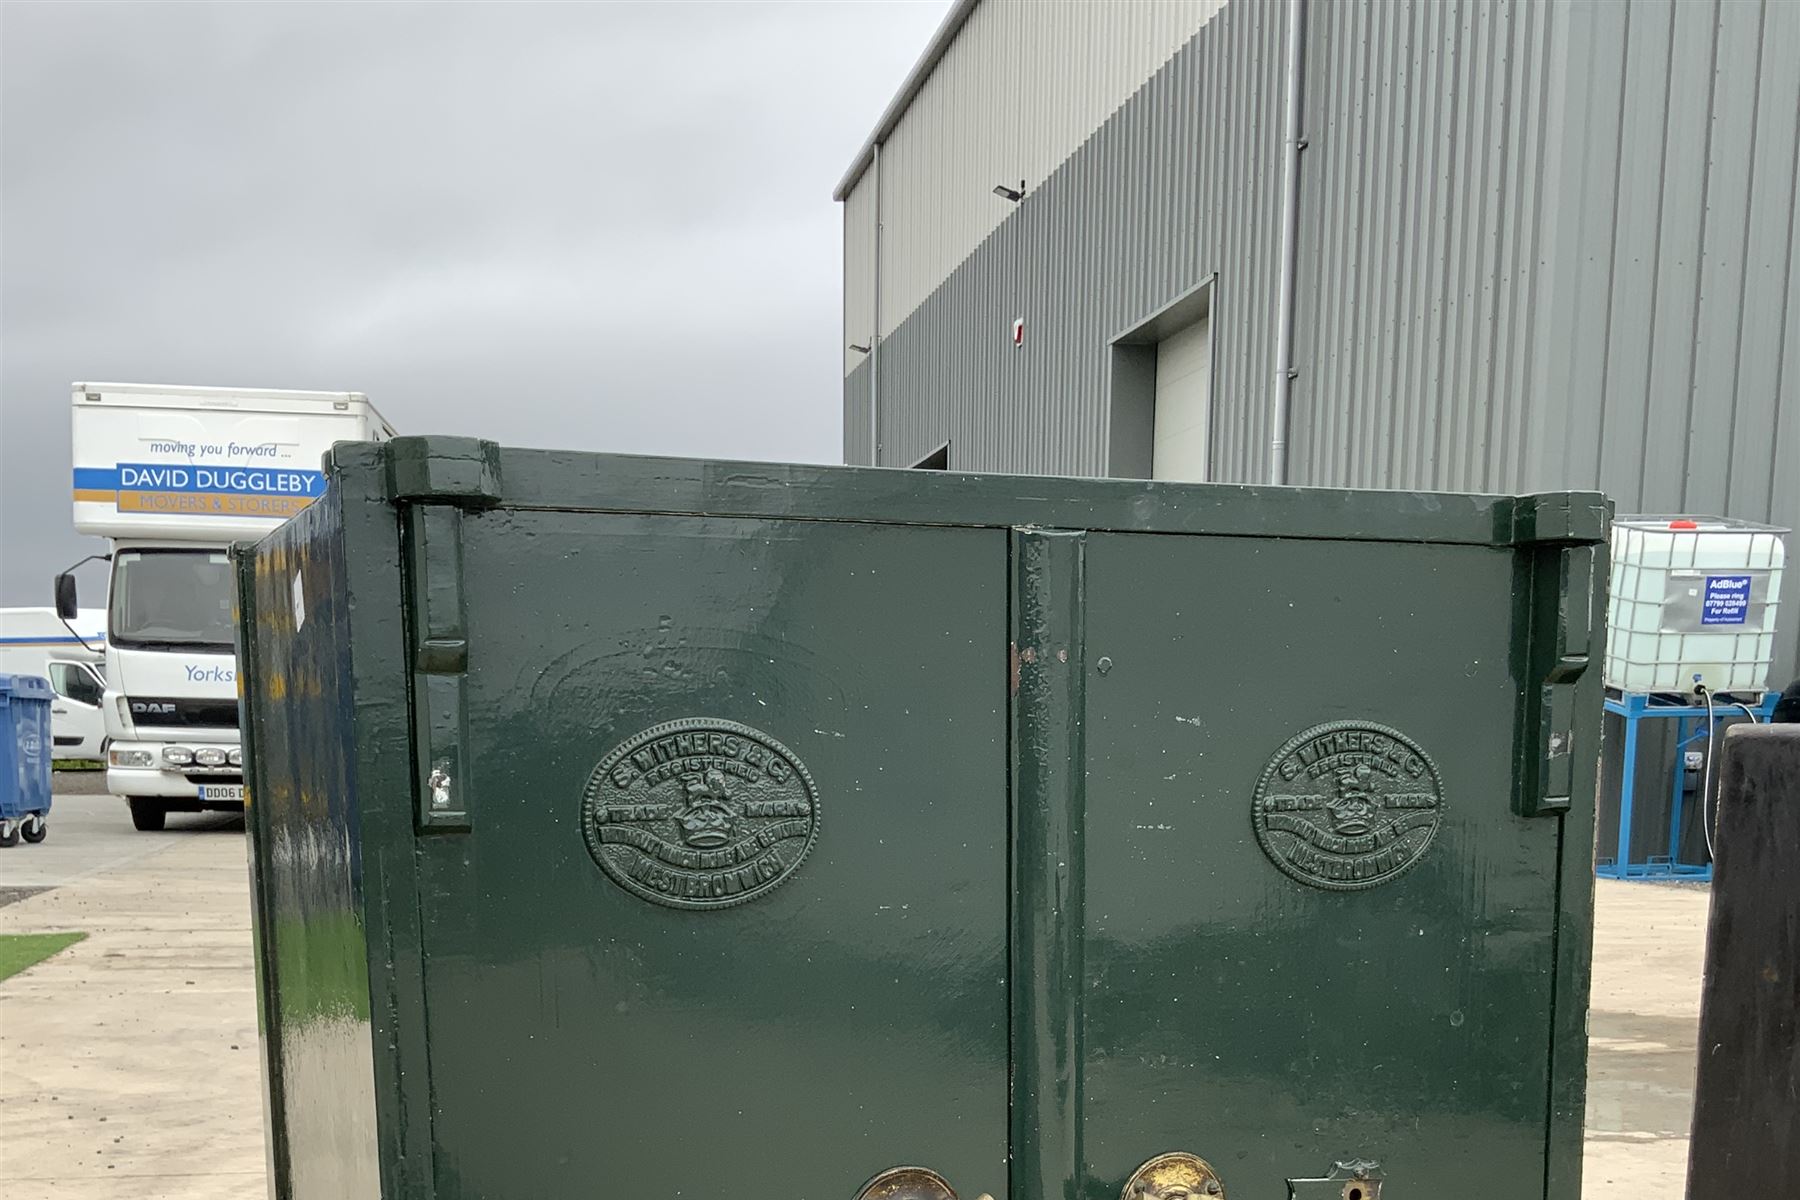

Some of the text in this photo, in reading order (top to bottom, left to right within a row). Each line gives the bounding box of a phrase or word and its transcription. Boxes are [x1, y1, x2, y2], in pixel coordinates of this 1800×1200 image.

[150, 441, 195, 458] moving
[201, 444, 223, 459] you
[228, 442, 278, 459] forward
[121, 468, 317, 493] DAVID DUGGLEBY
[140, 495, 207, 511] MOVERS
[212, 498, 222, 510] &
[1731, 593, 1744, 601] ring
[132, 703, 176, 714] DAF
[631, 732, 739, 770] WITHERS
[1297, 731, 1390, 767] WITHERS
[644, 756, 762, 787] REGISTERED
[206, 788, 235, 799] DD06
[609, 801, 799, 821] TRADE MARK
